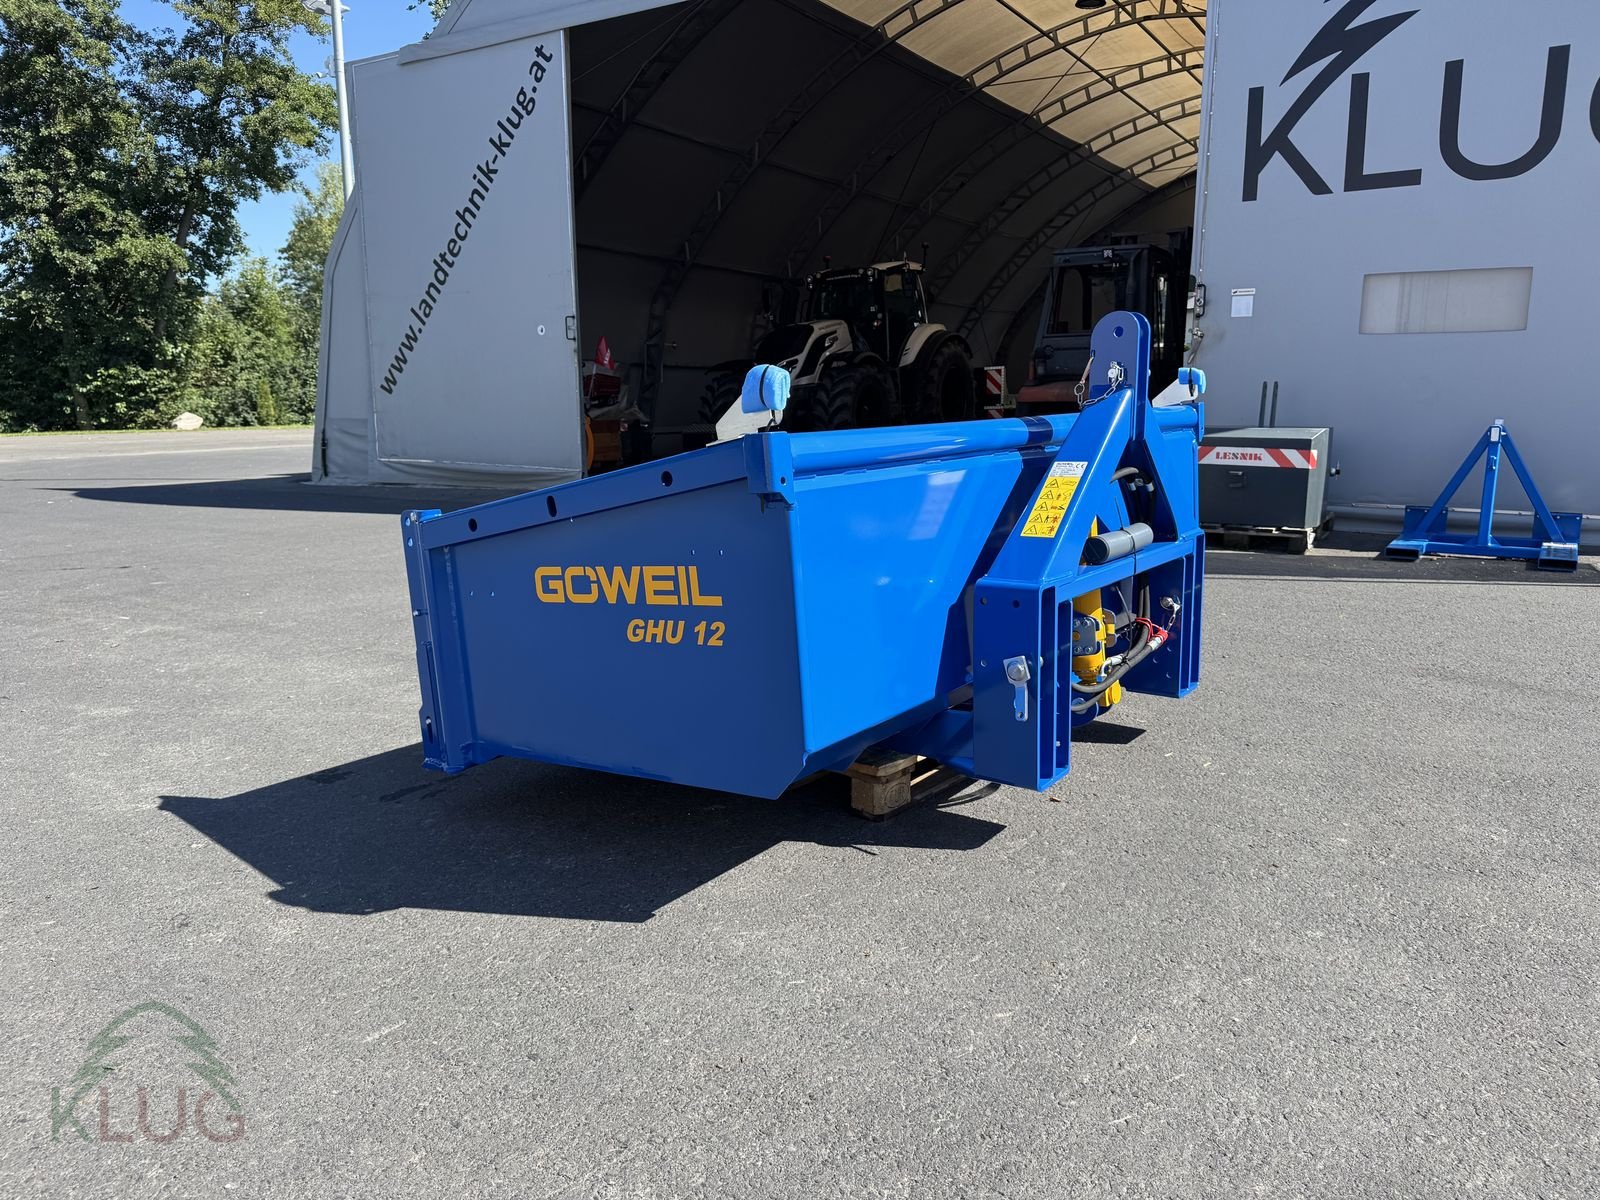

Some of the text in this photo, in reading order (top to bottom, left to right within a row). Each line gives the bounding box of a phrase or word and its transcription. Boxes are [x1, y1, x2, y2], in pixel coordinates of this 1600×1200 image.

[1242, 10, 1600, 203] KLU
[379, 43, 554, 396] www.landtechnik-klug.at
[626, 618, 726, 647] GHU 12
